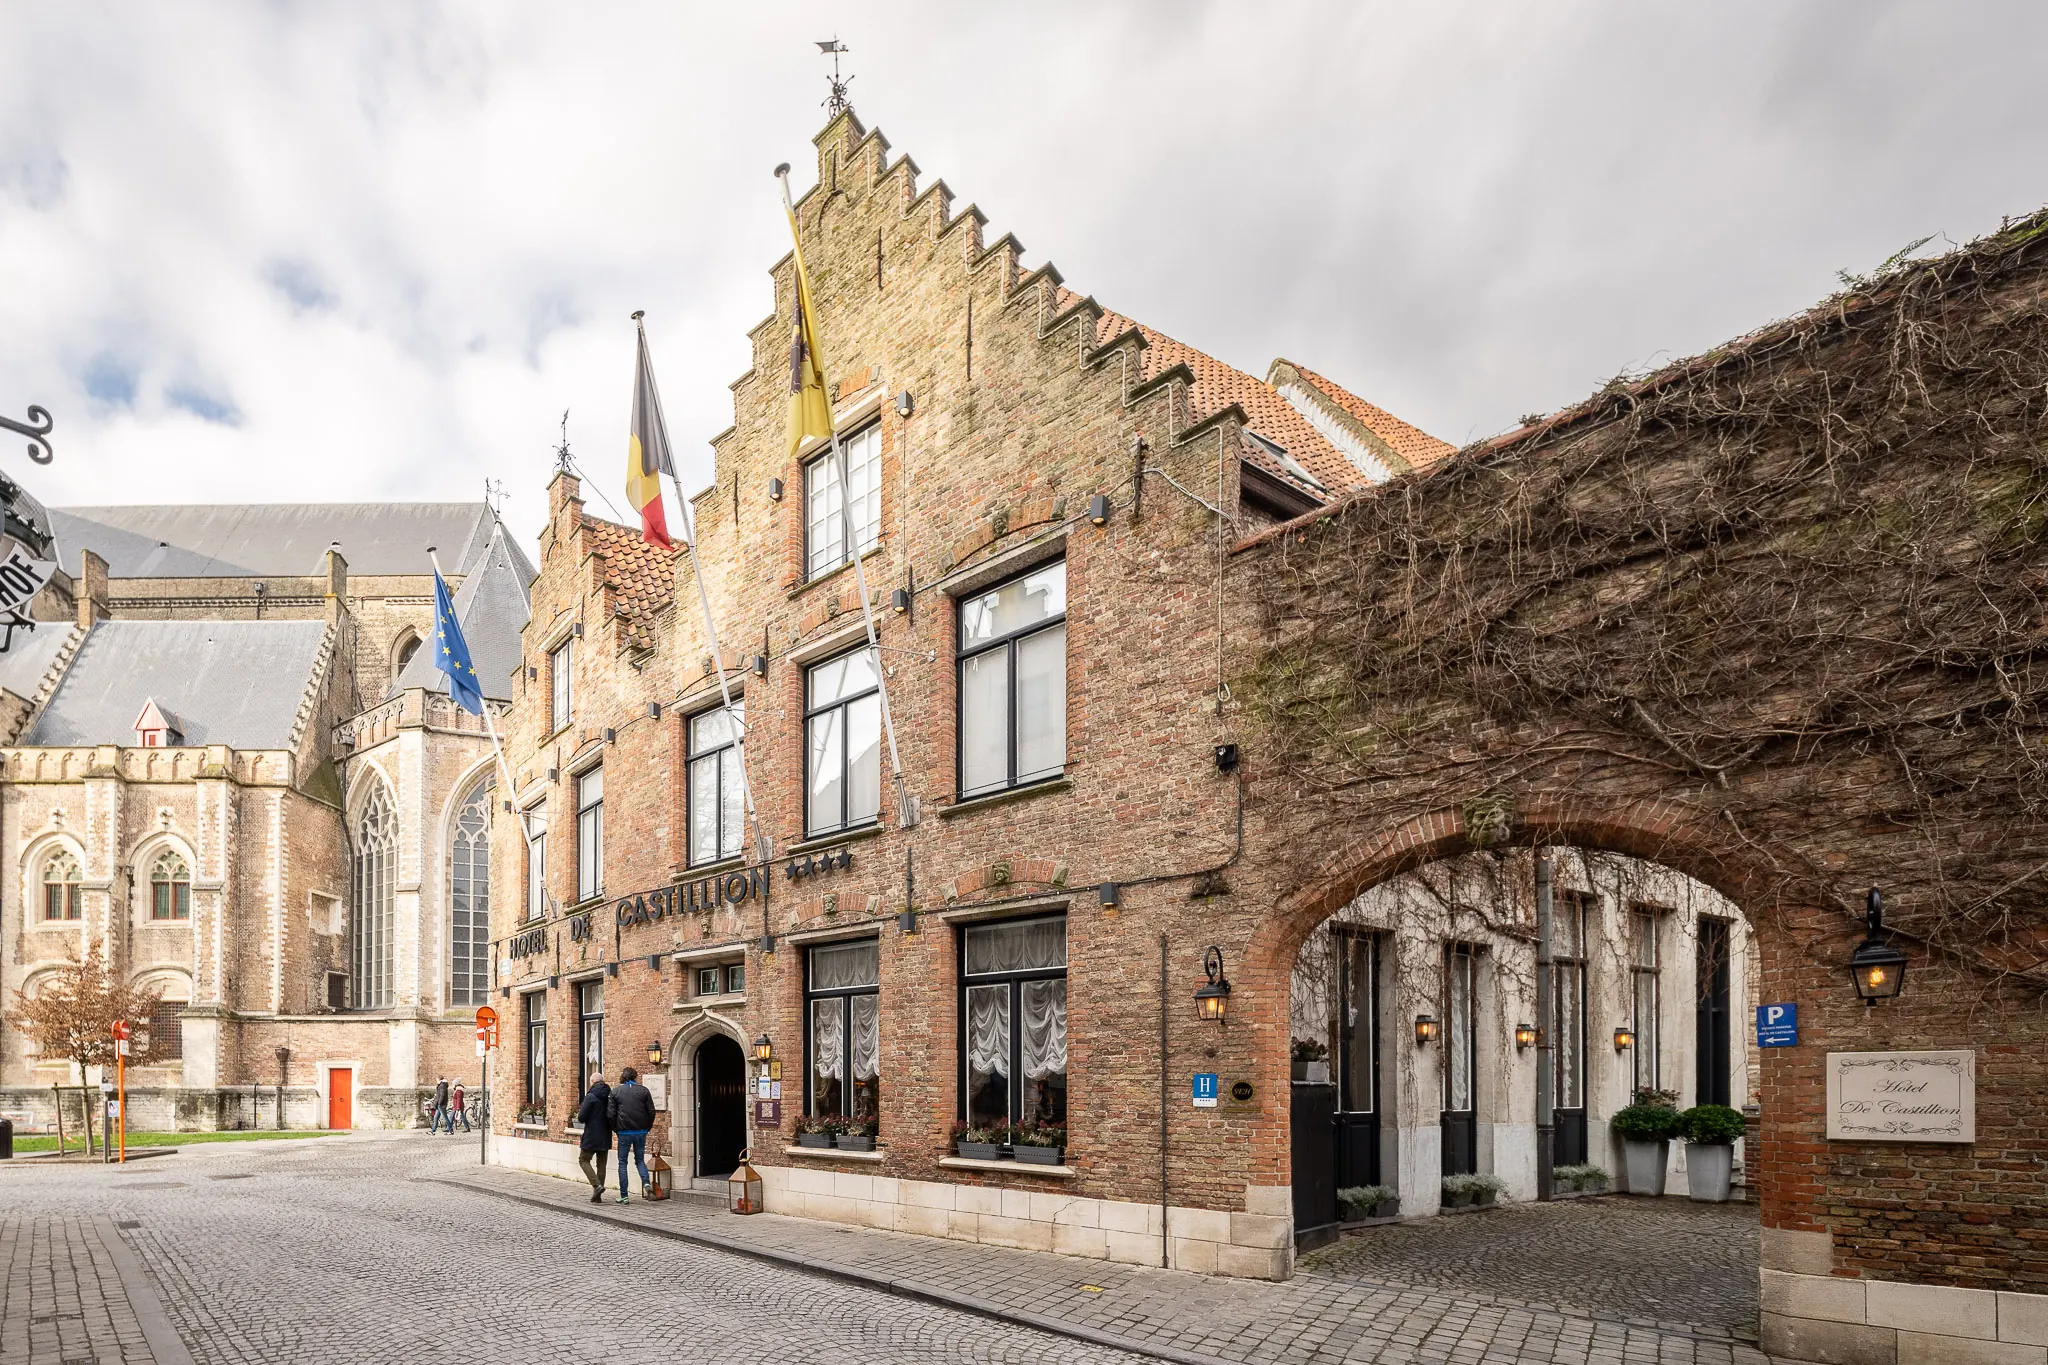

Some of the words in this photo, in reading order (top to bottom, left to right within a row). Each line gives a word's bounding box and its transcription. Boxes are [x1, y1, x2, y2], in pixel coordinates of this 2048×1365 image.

[510, 929, 547, 960] HOTEL
[570, 913, 591, 941] DE
[616, 866, 770, 927] CASTILLION
[1768, 1006, 1784, 1024] P
[1200, 1078, 1210, 1092] H
[1873, 1079, 1928, 1094] Hotel
[1838, 1100, 1874, 1114] De
[1877, 1100, 1961, 1115] Castillion
